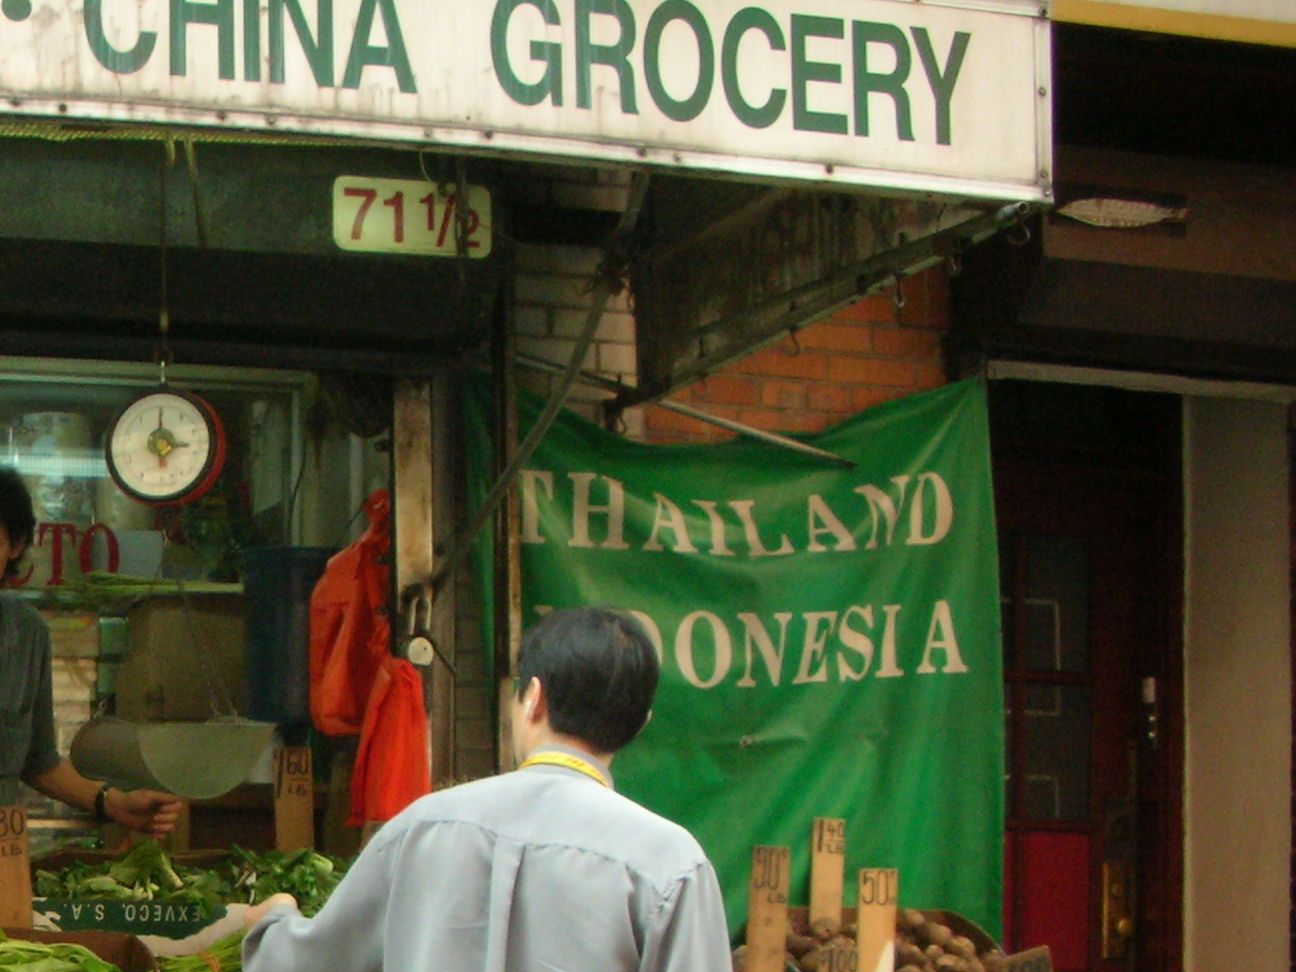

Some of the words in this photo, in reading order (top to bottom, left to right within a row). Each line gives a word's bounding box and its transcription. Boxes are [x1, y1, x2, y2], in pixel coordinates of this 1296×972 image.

[83, 0, 417, 93] CHINA
[491, 0, 971, 146] GROCERY
[519, 470, 954, 557] THAILAND
[534, 599, 968, 690] ONESIA
